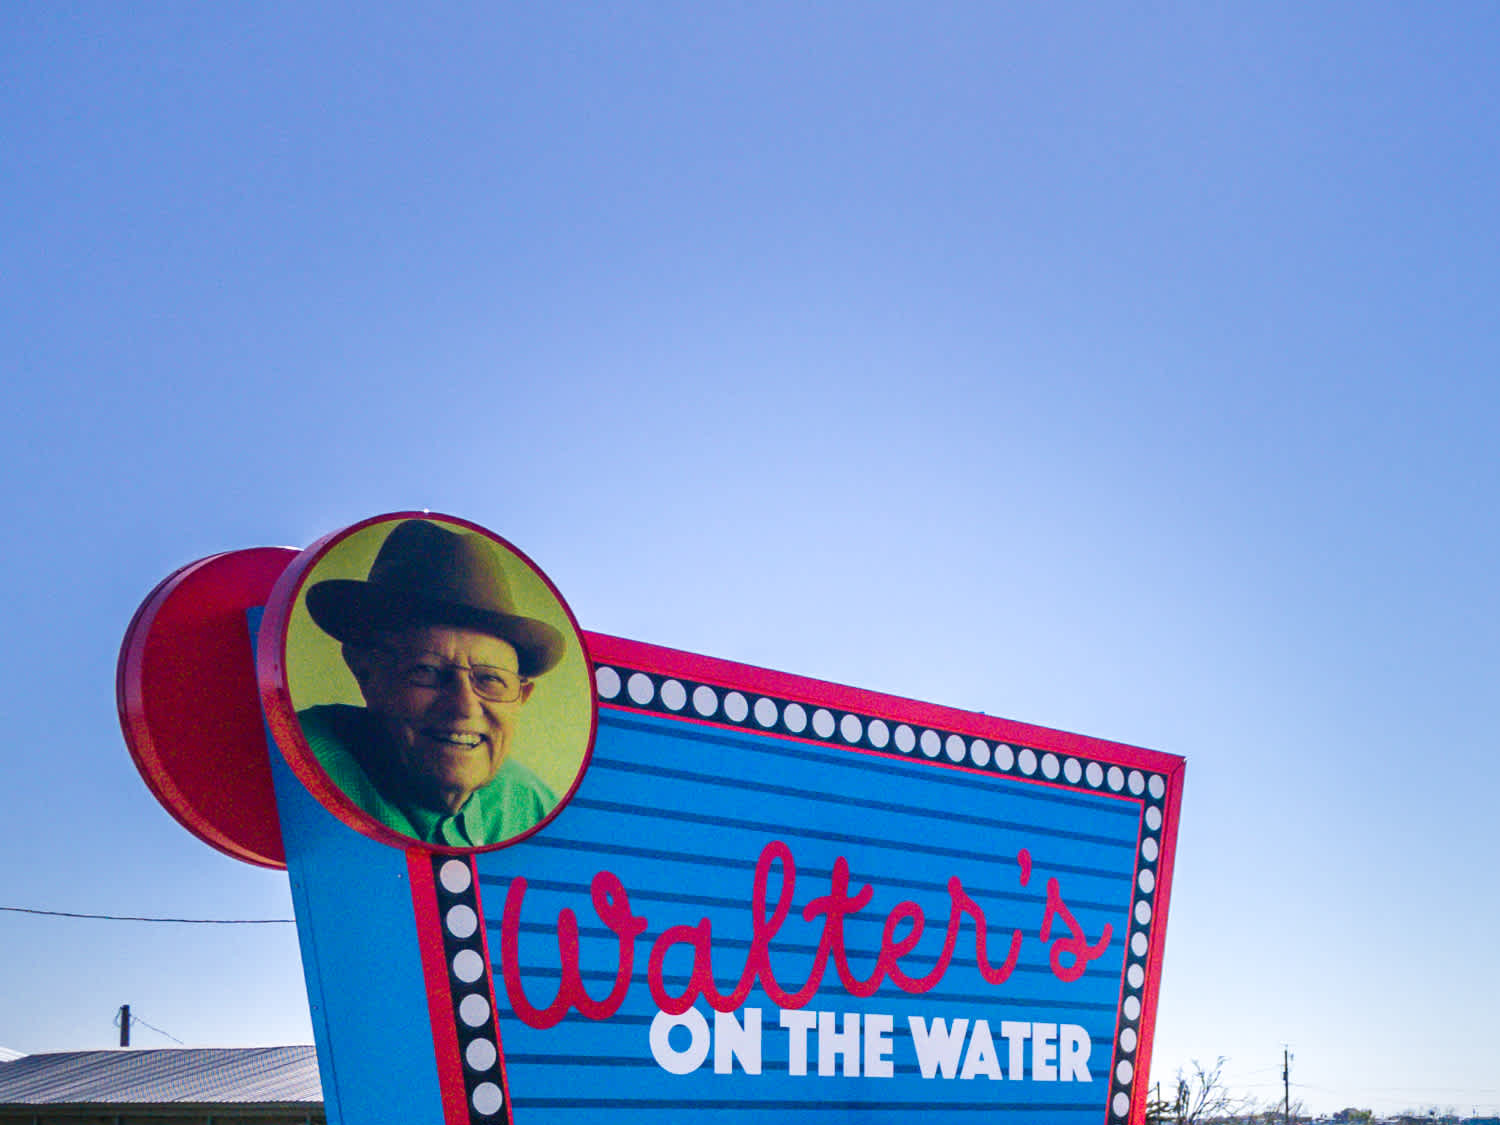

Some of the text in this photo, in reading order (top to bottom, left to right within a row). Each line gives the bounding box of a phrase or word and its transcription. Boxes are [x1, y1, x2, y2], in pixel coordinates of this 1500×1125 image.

[501, 840, 1113, 1030] Walter's
[649, 1005, 1094, 1082] ON THE WATER
